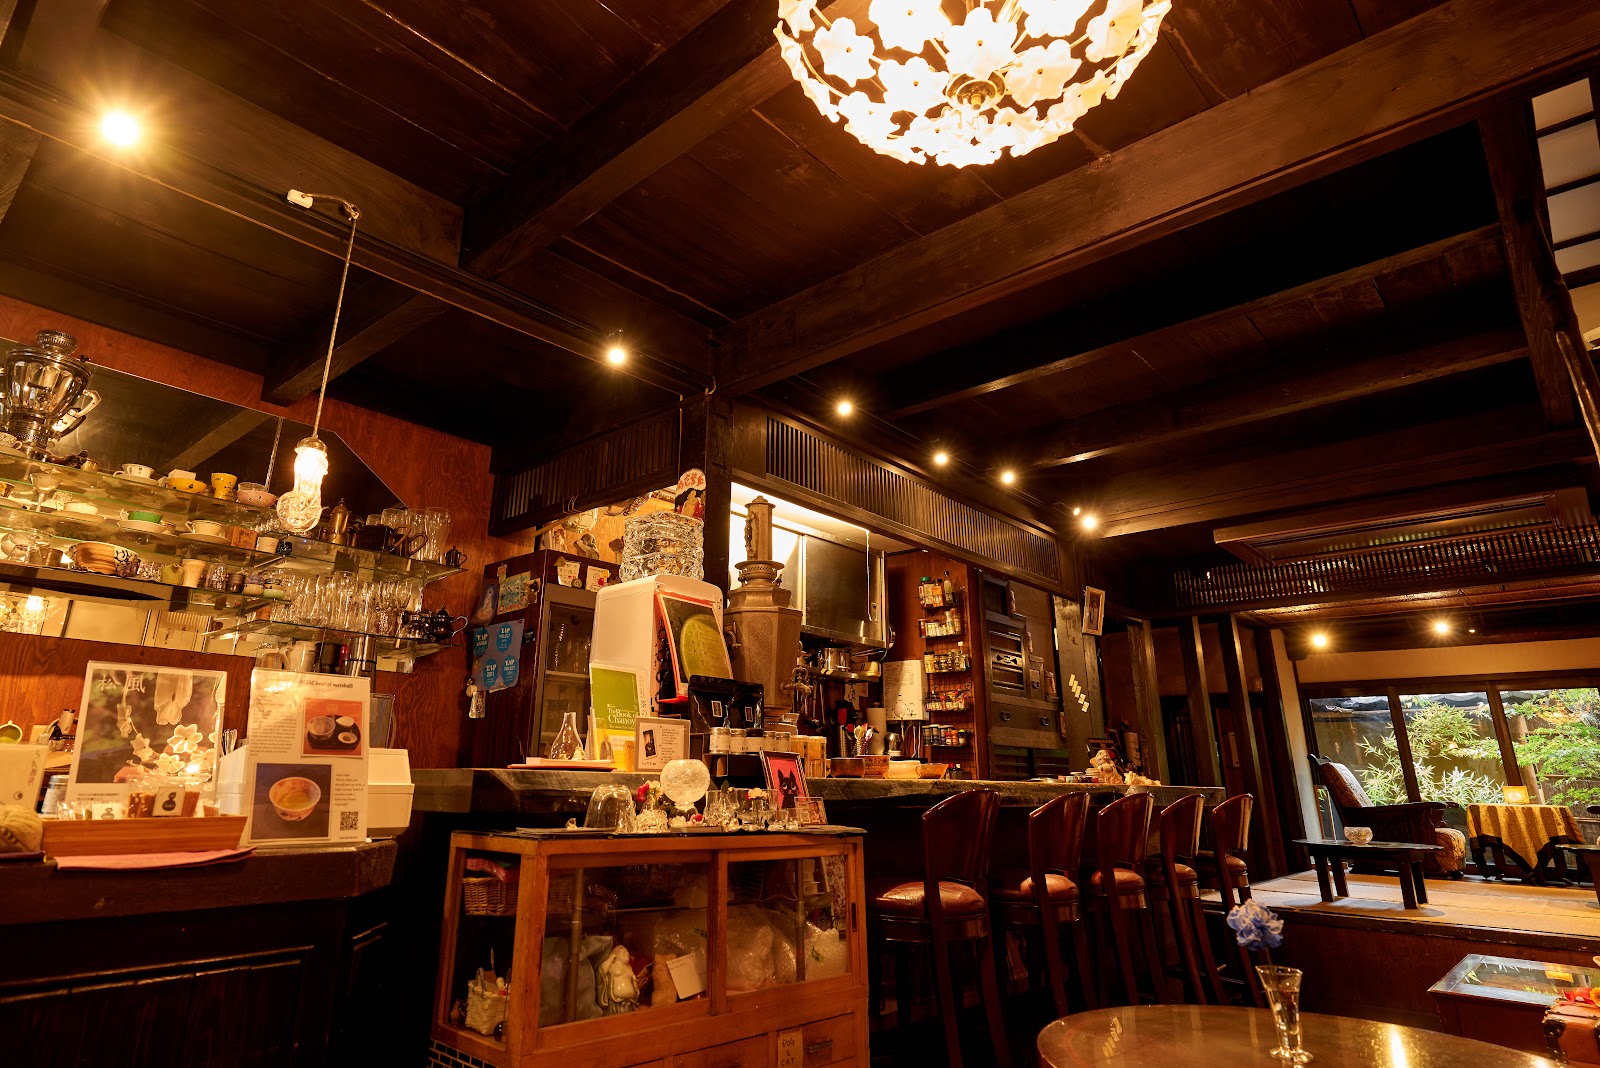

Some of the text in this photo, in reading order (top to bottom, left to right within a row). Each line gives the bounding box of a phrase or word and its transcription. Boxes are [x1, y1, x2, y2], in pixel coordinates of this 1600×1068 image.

[96, 673, 146, 694] 松風
[616, 708, 633, 718] Book
[782, 1037, 795, 1048] DOG
[780, 1057, 795, 1067] CAT
